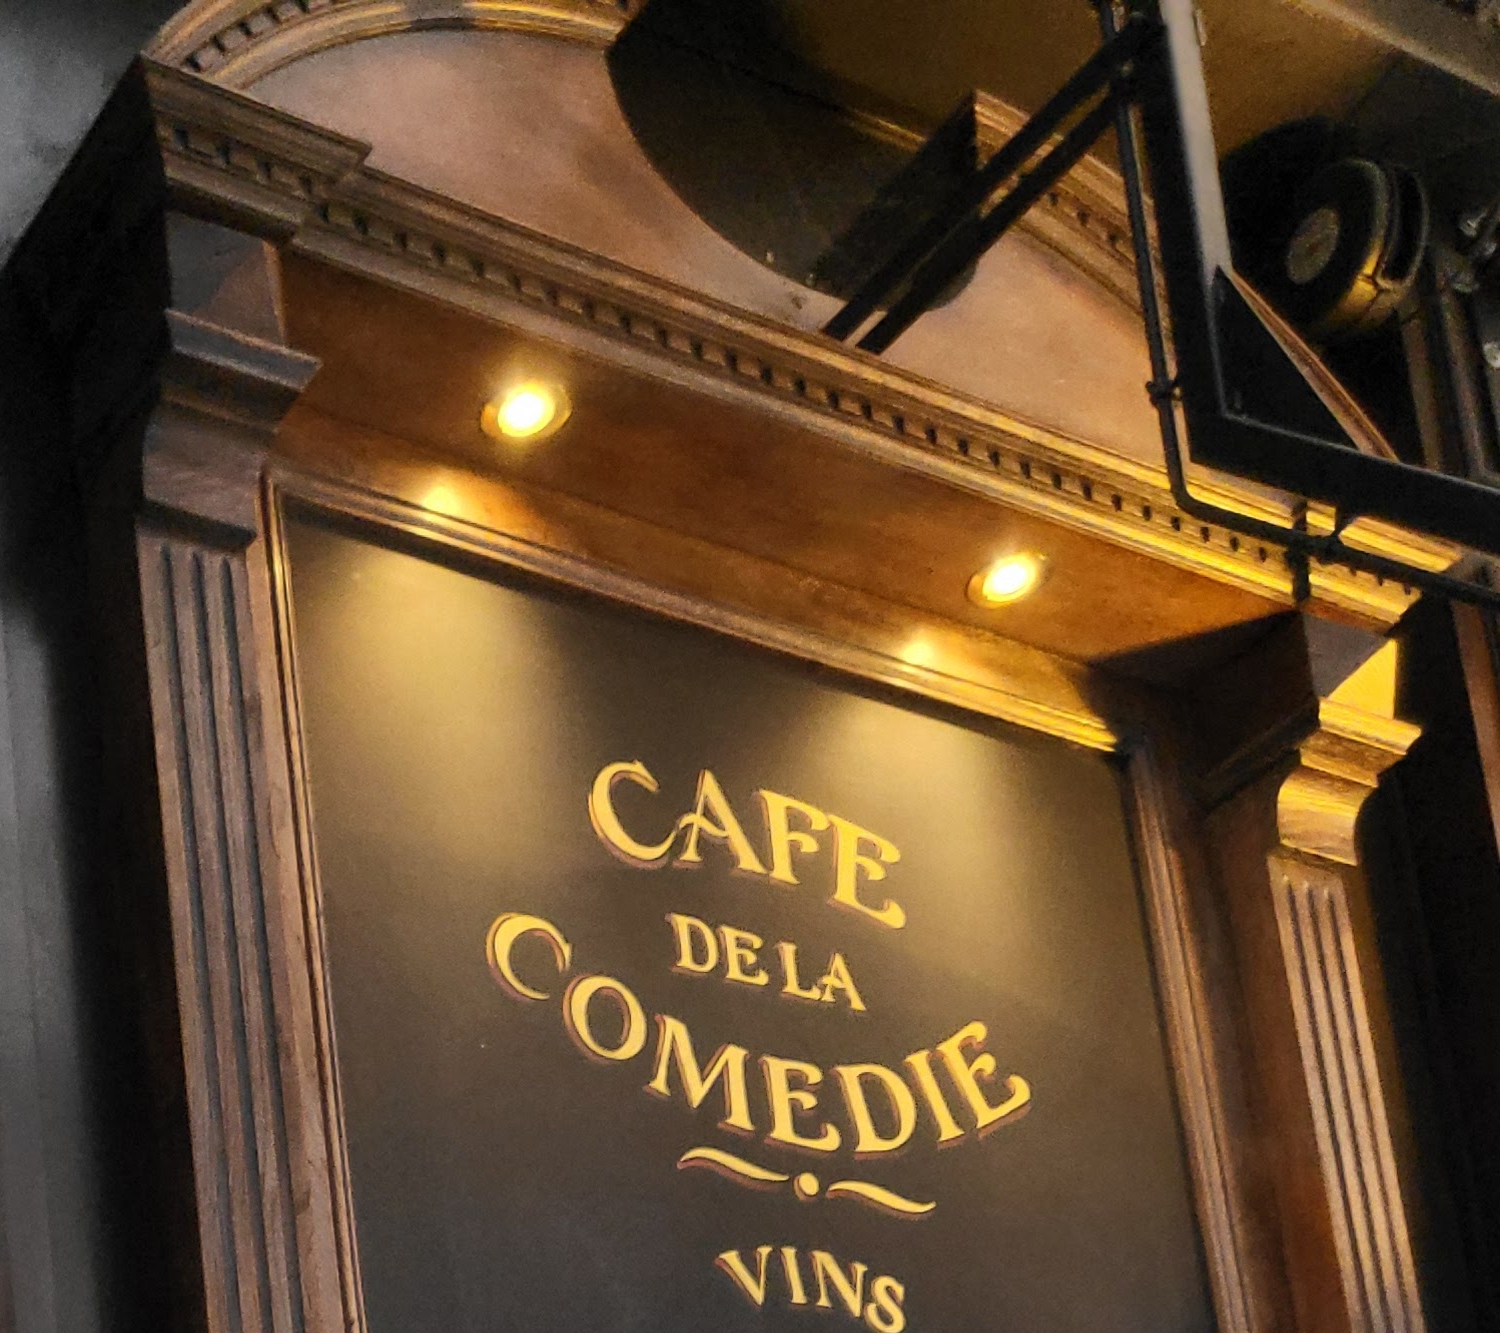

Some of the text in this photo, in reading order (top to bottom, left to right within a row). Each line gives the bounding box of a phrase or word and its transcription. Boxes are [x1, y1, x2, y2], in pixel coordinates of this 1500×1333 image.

[588, 760, 907, 929] CAFE
[486, 912, 1031, 1159] COMEDIE
[666, 911, 867, 1011] DE LA
